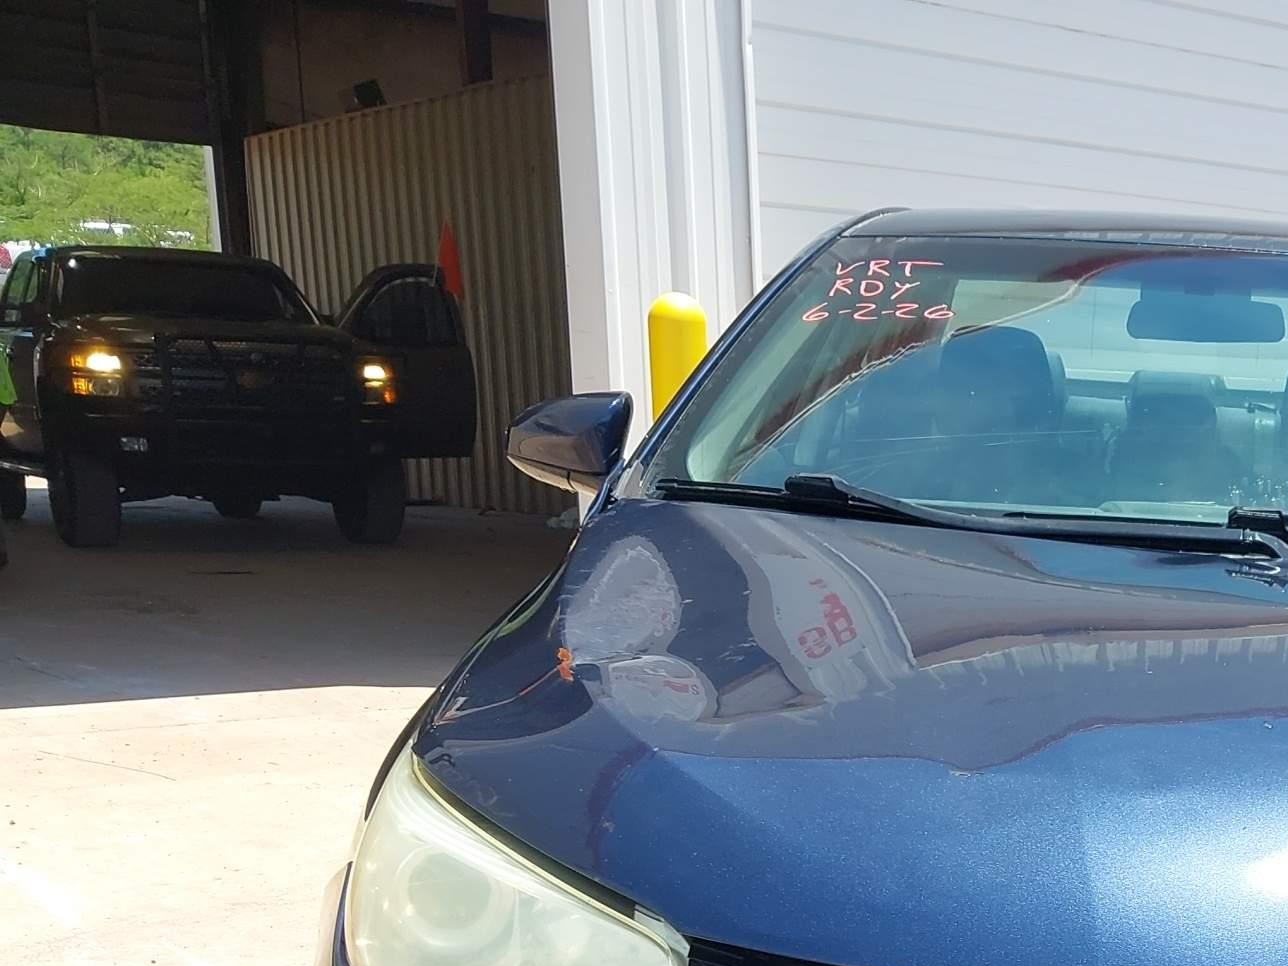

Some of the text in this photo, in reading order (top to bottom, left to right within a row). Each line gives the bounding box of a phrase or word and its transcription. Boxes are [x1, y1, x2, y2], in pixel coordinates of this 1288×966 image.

[836, 259, 944, 277] VRT
[828, 278, 920, 299] RDY
[802, 302, 955, 321] 6-2-26
